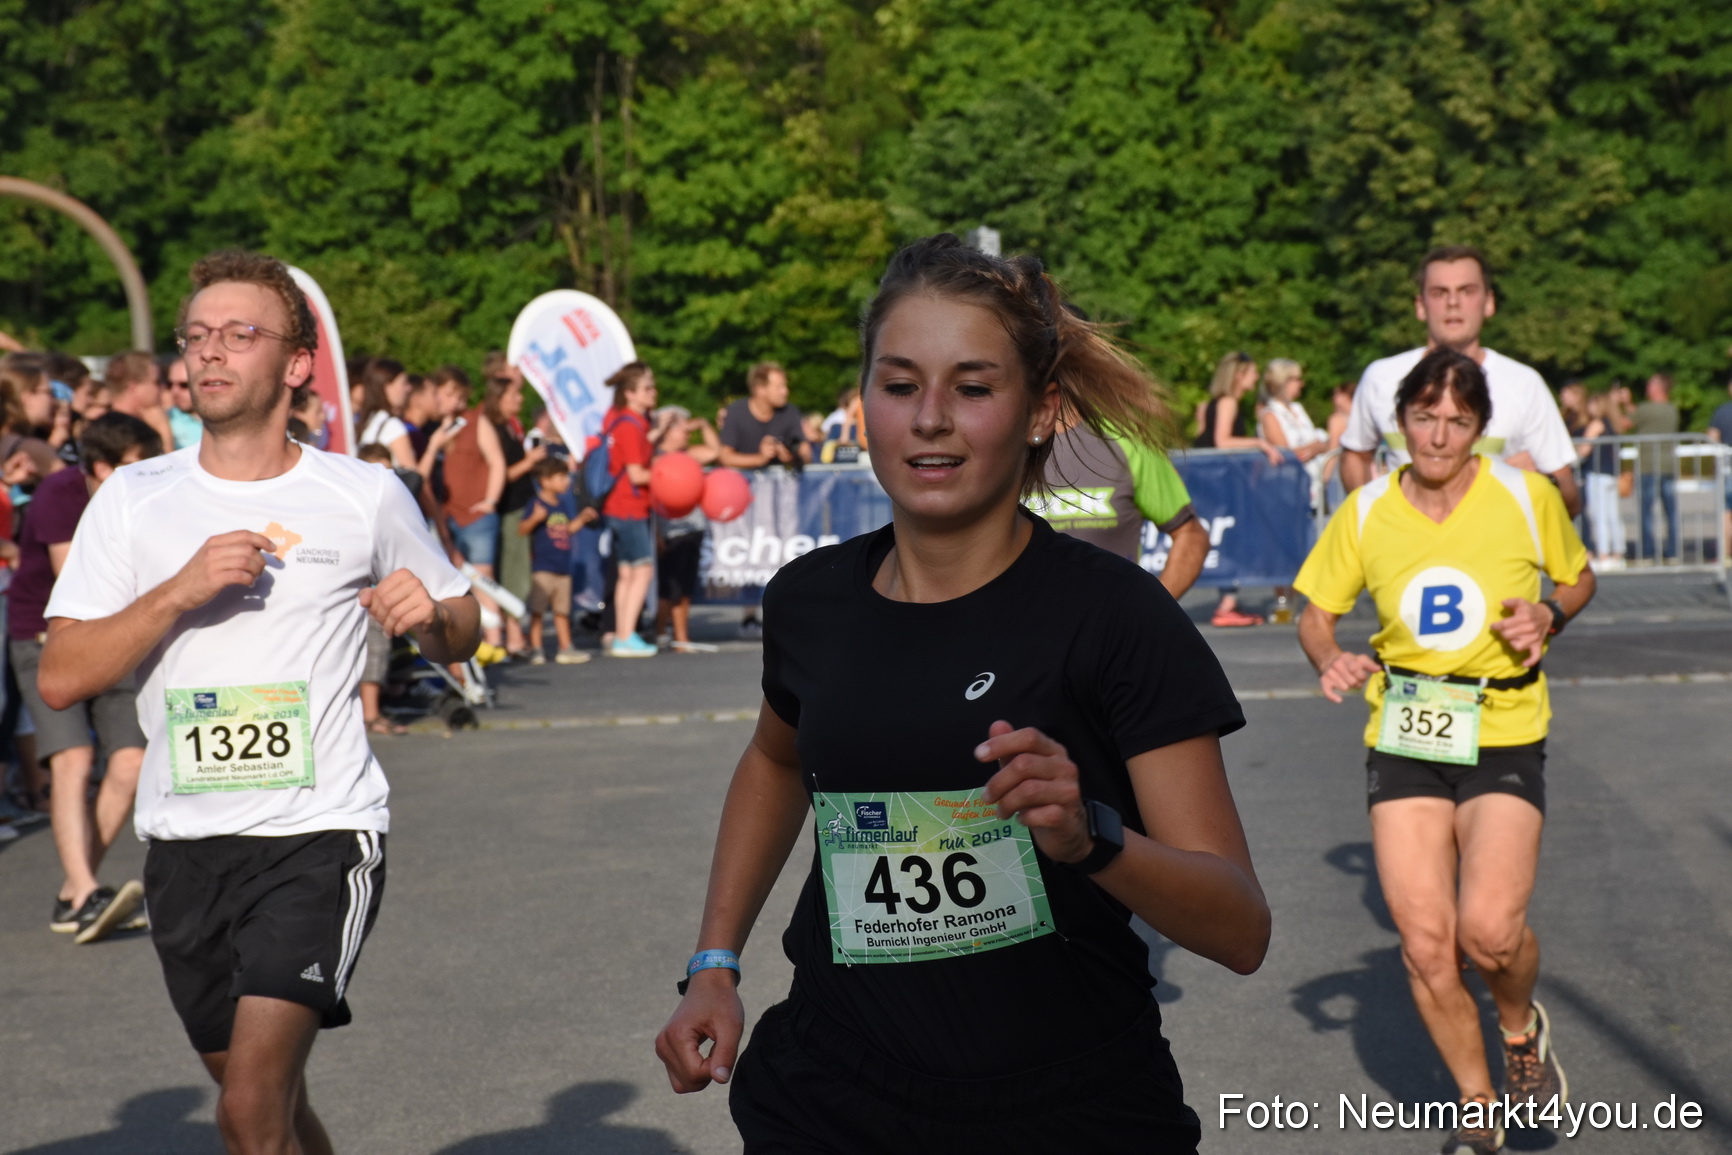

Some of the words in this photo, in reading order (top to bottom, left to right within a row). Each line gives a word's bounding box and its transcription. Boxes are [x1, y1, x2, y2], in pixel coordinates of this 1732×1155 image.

[296, 548, 340, 558] LANDKREIS
[296, 556, 340, 566] NEUMARKT
[1418, 584, 1464, 636] B
[273, 709, 300, 720] 2019
[1400, 706, 1453, 739] 352
[185, 721, 291, 762] 1328
[197, 765, 226, 774] Amler
[230, 762, 284, 773] Sebastian
[934, 797, 971, 808] Gesunde
[846, 826, 918, 842] firmenlauf
[972, 825, 1012, 847] 2019
[864, 852, 987, 914] 436
[855, 918, 939, 934] Federhofer
[943, 904, 1017, 929] Ramona
[867, 936, 910, 947] Burnickl
[912, 931, 966, 947] Ingenieur
[969, 921, 1007, 937] GmbH
